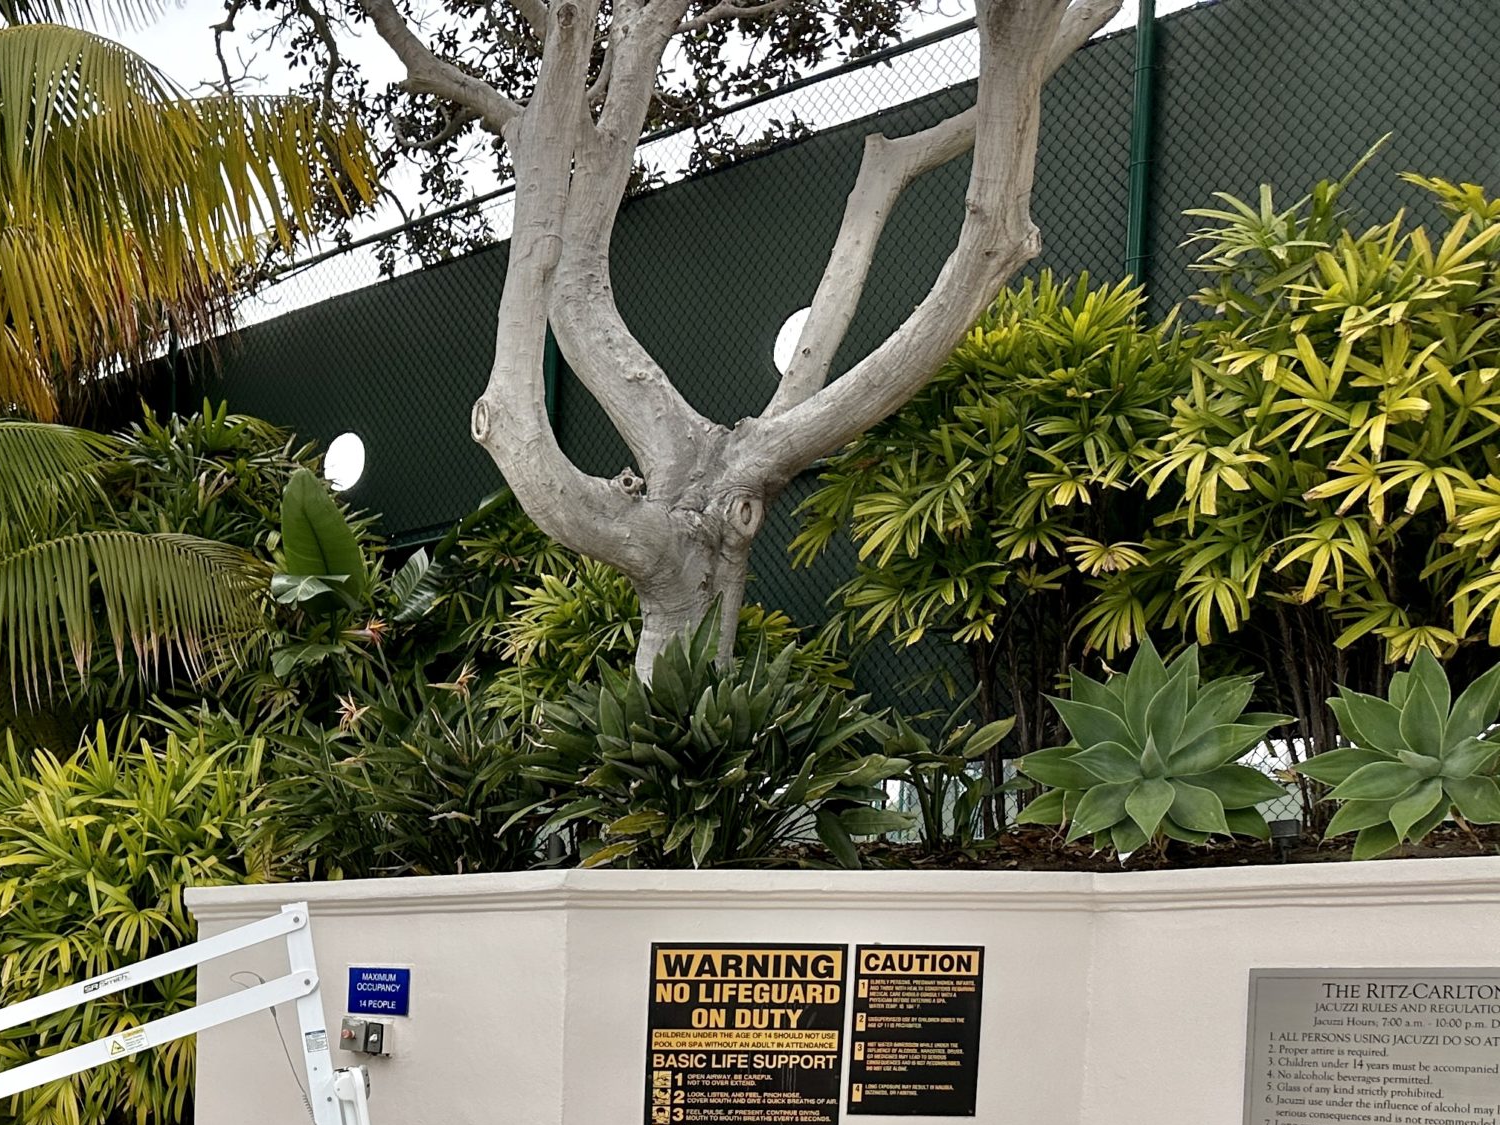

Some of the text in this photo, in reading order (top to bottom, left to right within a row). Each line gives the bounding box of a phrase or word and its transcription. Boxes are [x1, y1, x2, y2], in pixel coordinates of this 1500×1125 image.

[663, 954, 835, 979] WARNING
[864, 953, 972, 972] CAUTION
[362, 973, 396, 981] MAXIMUM
[357, 982, 400, 992] OCCUPANCY
[656, 983, 840, 1004] NO LIFEGUARD
[1322, 983, 1361, 999] THE
[368, 1000, 396, 1009] PEOPLE
[1314, 1002, 1359, 1013] JACUZZI
[1362, 1003, 1398, 1012] RULES
[1401, 1004, 1427, 1013] AND
[692, 1008, 803, 1029] ON DUTY
[859, 1015, 864, 1023] 2
[1313, 1017, 1343, 1027] Jacuzzi
[1382, 1018, 1402, 1027] 7:00
[1279, 1032, 1299, 1041] ALL
[1302, 1033, 1351, 1043] PERSONS
[1354, 1034, 1390, 1044] USING
[1392, 1035, 1439, 1046] JACUZZI
[1443, 1036, 1461, 1045] DO
[1464, 1036, 1481, 1046] SO
[1279, 1044, 1308, 1055] Proper
[1311, 1047, 1334, 1055] attire
[653, 1053, 837, 1069] BASIC LIFE SUPPORT
[1278, 1057, 1318, 1067] Children
[1322, 1059, 1349, 1069] under
[1354, 1059, 1363, 1069] 14
[1366, 1063, 1389, 1071] years
[1392, 1063, 1416, 1071] must
[1419, 1061, 1430, 1071] be
[1433, 1064, 1499, 1075] accompanied
[674, 1072, 683, 1086] 1
[1278, 1070, 1291, 1079] No
[1294, 1071, 1335, 1081] alcoholic
[1338, 1072, 1381, 1084] beverages
[673, 1090, 685, 1104] 2
[1277, 1082, 1301, 1092] Glass
[1303, 1083, 1312, 1093] of
[1315, 1087, 1331, 1096] any
[1334, 1085, 1354, 1094] kind
[1357, 1086, 1387, 1097] strictly
[1391, 1088, 1444, 1098] prohibited.
[1276, 1095, 1305, 1105] Jacuzzi
[1326, 1097, 1353, 1107] under
[1356, 1099, 1371, 1108] the
[1374, 1100, 1418, 1111] influence
[1421, 1102, 1432, 1111] of
[1434, 1102, 1470, 1113] alcohol
[1474, 1107, 1494, 1116] may
[672, 1108, 684, 1121] 3
[1276, 1110, 1307, 1118] serious
[1309, 1112, 1371, 1121] consequences
[1374, 1113, 1392, 1123] and
[1396, 1115, 1402, 1123] is
[1405, 1116, 1422, 1124] not
